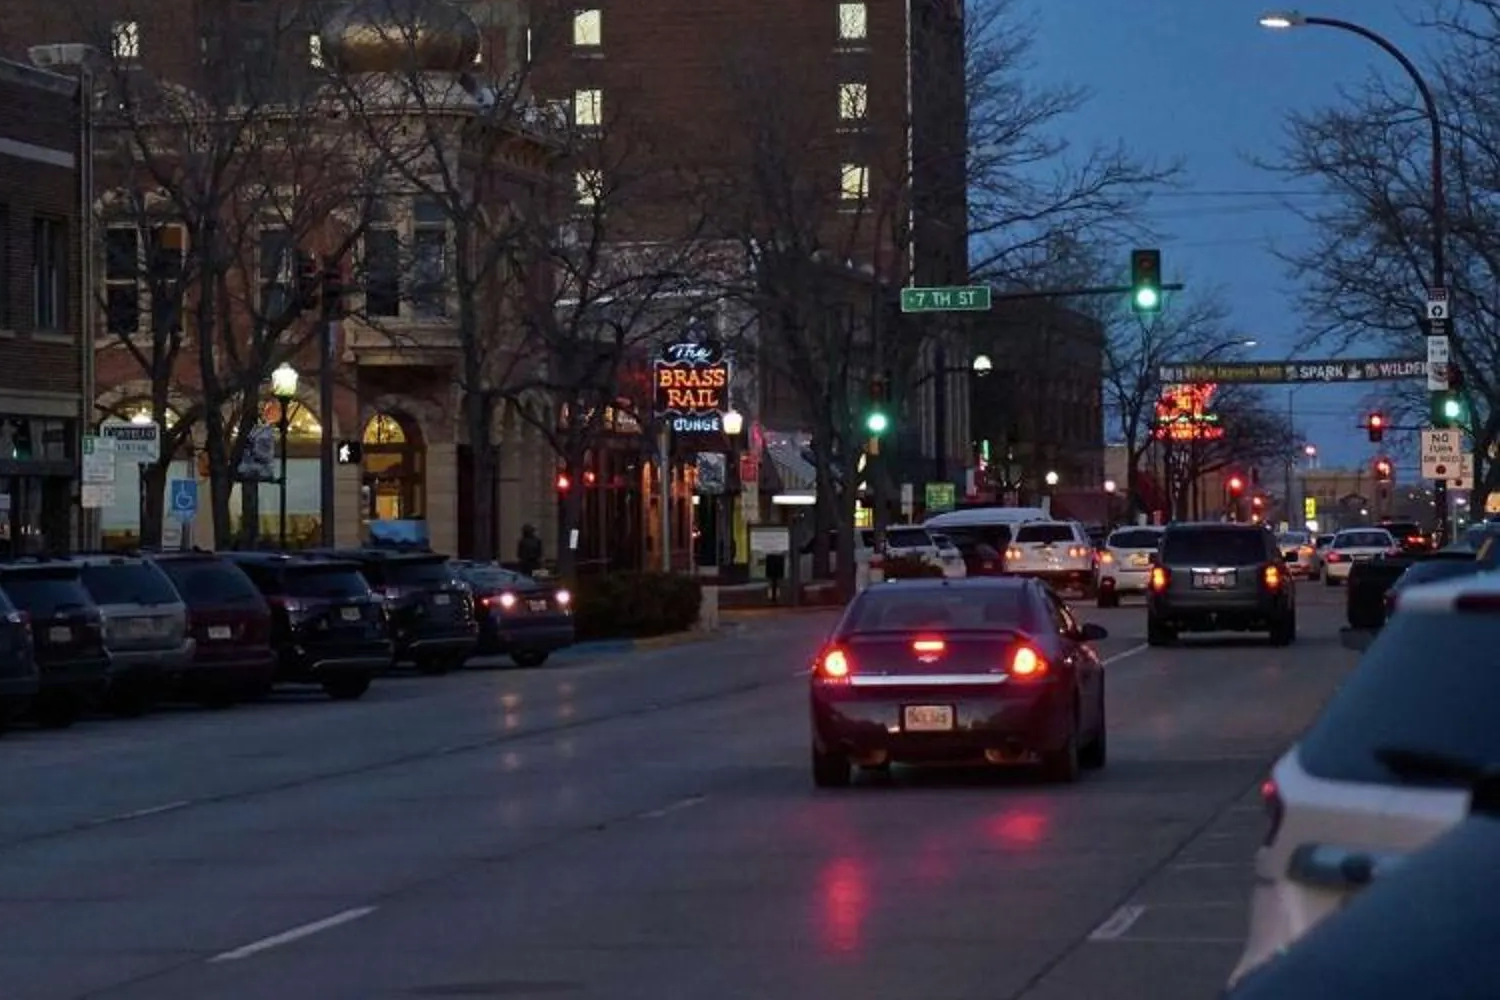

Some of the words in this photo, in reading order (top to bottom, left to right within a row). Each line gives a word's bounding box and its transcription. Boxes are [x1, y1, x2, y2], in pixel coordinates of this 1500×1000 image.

[916, 293, 925, 306] 7
[932, 292, 951, 306] TH
[959, 291, 976, 305] ST
[668, 343, 713, 359] The
[659, 369, 725, 387] BRASS
[1299, 366, 1344, 380] SPARK
[1380, 363, 1429, 377] WILDFI
[667, 389, 719, 407] RAIL
[666, 417, 719, 431] OUNGE
[1431, 433, 1449, 443] NO
